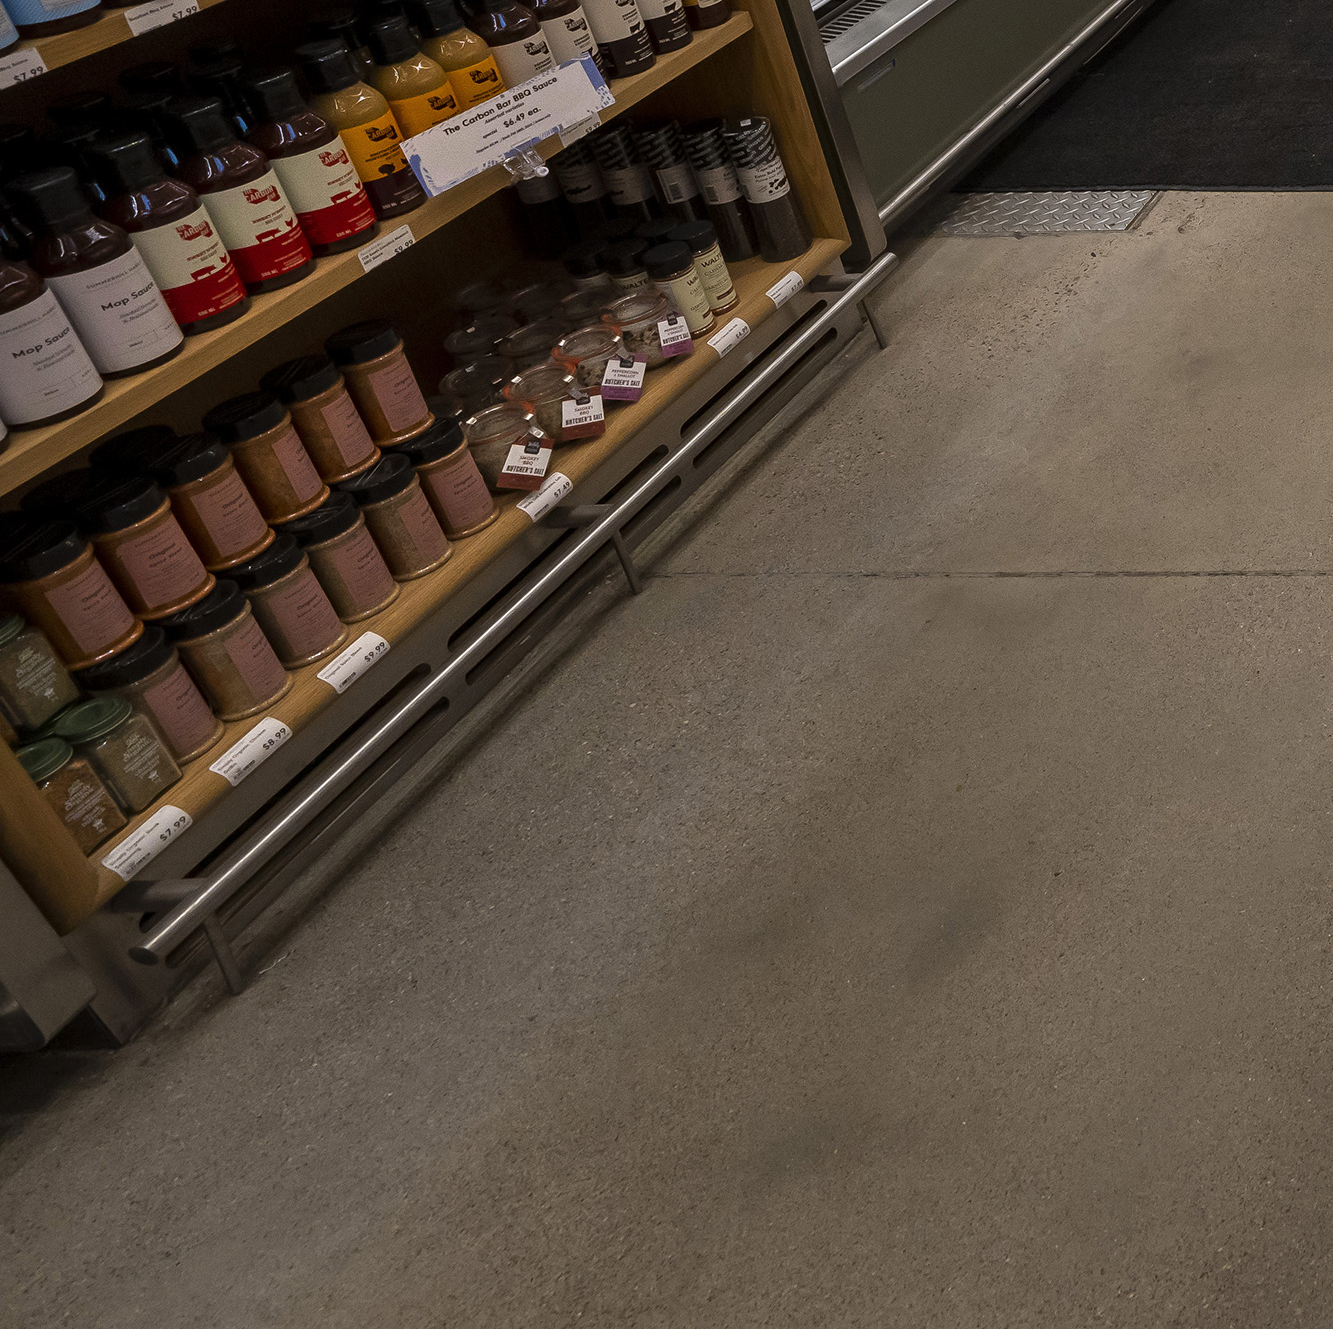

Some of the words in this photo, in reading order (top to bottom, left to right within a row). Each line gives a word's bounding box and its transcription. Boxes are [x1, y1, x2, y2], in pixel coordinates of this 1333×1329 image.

[171, 5, 198, 22] $7.99
[13, 66, 44, 85] $7.99
[443, 124, 461, 137] The
[462, 108, 495, 127] Carbon
[496, 99, 512, 111] Bar
[513, 88, 532, 102] BBQ
[532, 76, 558, 93] Sauce
[502, 112, 526, 128] $6.49
[527, 106, 542, 117] ea.
[101, 296, 128, 312] Mop
[130, 281, 155, 299] Sauce
[11, 343, 44, 359] Mop
[45, 326, 71, 344] Sauce
[553, 481, 571, 498] $7.49
[364, 640, 387, 662] $9.99
[262, 726, 287, 751] $8.99
[159, 815, 187, 842] $7.99
